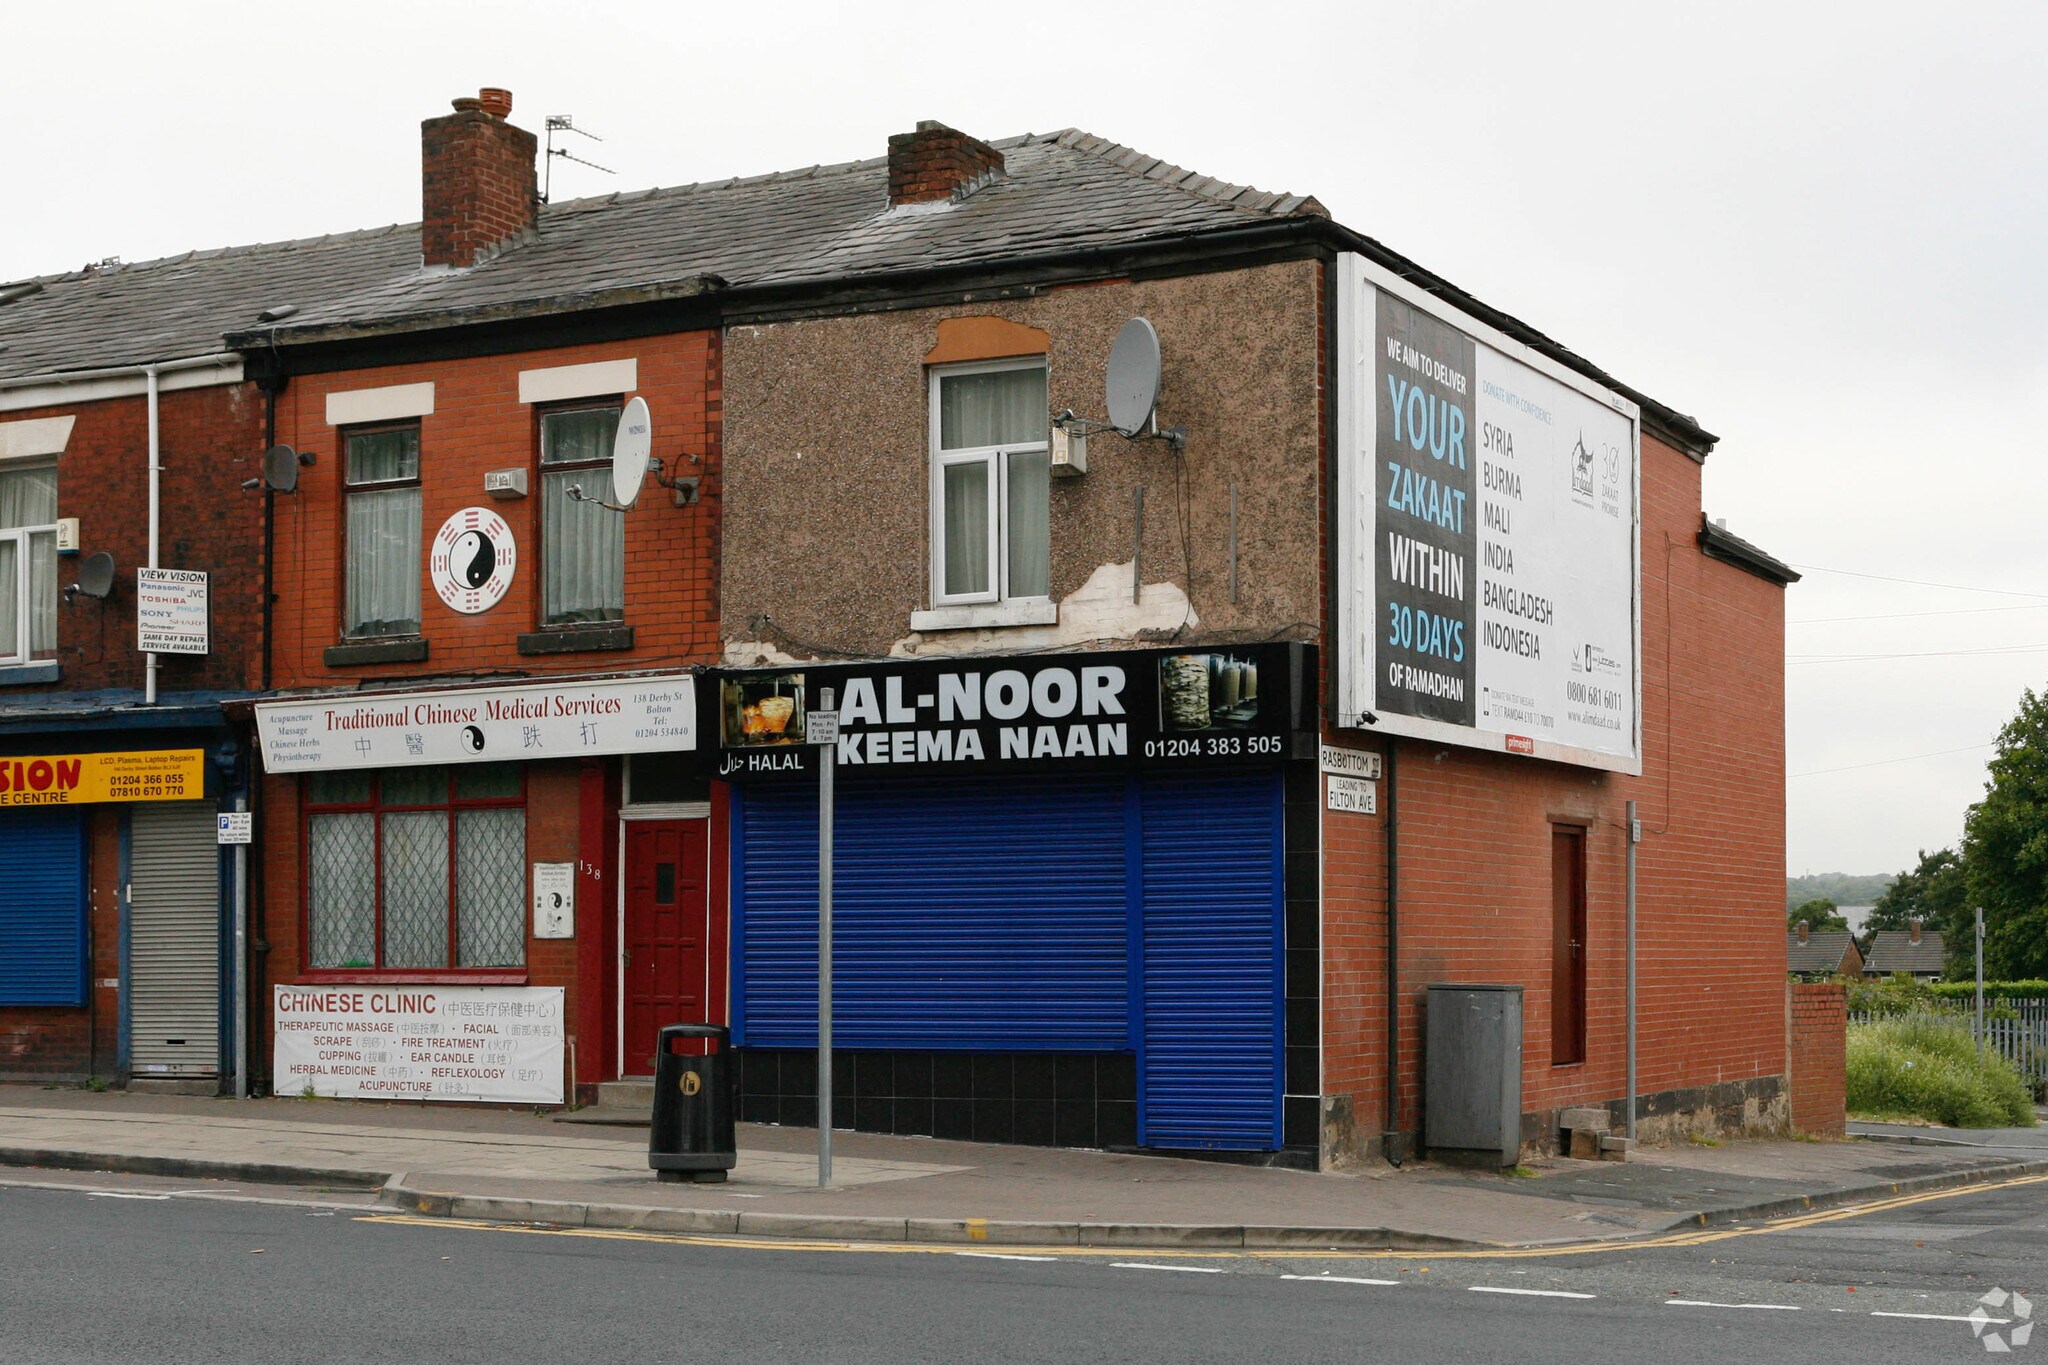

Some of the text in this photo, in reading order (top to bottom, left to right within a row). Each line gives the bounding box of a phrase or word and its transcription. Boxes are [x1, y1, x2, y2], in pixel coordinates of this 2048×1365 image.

[1387, 336, 1466, 395] WE AIM TO DELIVER
[1483, 380, 1551, 425] DONATE WITH CONFIDENCE
[1388, 373, 1465, 470] YOUR
[1484, 422, 1514, 459] SYRIA
[1484, 461, 1522, 501] BURMA
[1389, 462, 1465, 534] ZAKAAT
[1485, 501, 1510, 535] MALI
[1389, 532, 1463, 601] WITHIN
[1484, 541, 1514, 575] INDIA
[141, 570, 205, 582] VIEW VISION
[141, 583, 185, 591] Panasonic
[187, 590, 204, 598] JVC
[141, 596, 186, 604] TOSHIBA
[1484, 580, 1552, 626] BANGLADESH
[1389, 602, 1412, 649] 30
[1417, 610, 1464, 662] DAYS
[1484, 620, 1540, 660] INDONESIA
[1390, 662, 1464, 702] OF RAMADHAN
[634, 692, 682, 703] 138 Derby St
[840, 666, 1126, 726] AL-NOOR
[1567, 681, 1621, 711] 0800 681 6011
[325, 694, 621, 731] Traditional Chinese Medical Services
[647, 705, 671, 714] Bolton
[269, 714, 313, 724] Acupuncture
[653, 716, 668, 725] Tel:
[1568, 711, 1621, 730] www.alimdaad.co.uk
[279, 727, 308, 737] Massage
[635, 727, 688, 738] 01204 534840
[270, 738, 320, 749] Chinese Herbs
[838, 723, 1128, 765] KEEMA NAAN
[1145, 736, 1282, 758] 01204 383 505
[170, 754, 195, 762] Repairs
[273, 752, 321, 762] Physiotherapy
[720, 753, 744, 775] حلال
[749, 753, 804, 771] HALAL
[1323, 751, 1368, 772] RASBOTTOM
[111, 774, 184, 785] 01204 366 055
[1337, 779, 1367, 792] LEADING TO
[13, 792, 68, 804] CENTRE
[110, 786, 184, 797] 07810 670 770
[1330, 791, 1355, 808] FILTON
[581, 860, 600, 880] 138
[280, 993, 364, 1013] CHINESE
[371, 994, 436, 1014] CLINIC
[279, 1021, 344, 1032] THERAPEUTIC
[346, 1023, 394, 1032] MASSAGE
[464, 1024, 499, 1034] FACIAL
[314, 1036, 352, 1046] SCRAPE
[402, 1038, 423, 1048] FIRE
[427, 1038, 486, 1049] TREATMENT
[319, 1051, 361, 1061] CUPPING
[411, 1053, 431, 1062] EAR
[434, 1053, 474, 1063] CANDLE
[290, 1065, 328, 1075] HERBAL
[331, 1066, 376, 1076] MEDICINE
[432, 1068, 505, 1079] REFLEXOLOGY
[359, 1081, 432, 1092] ACUPUNCTURE
